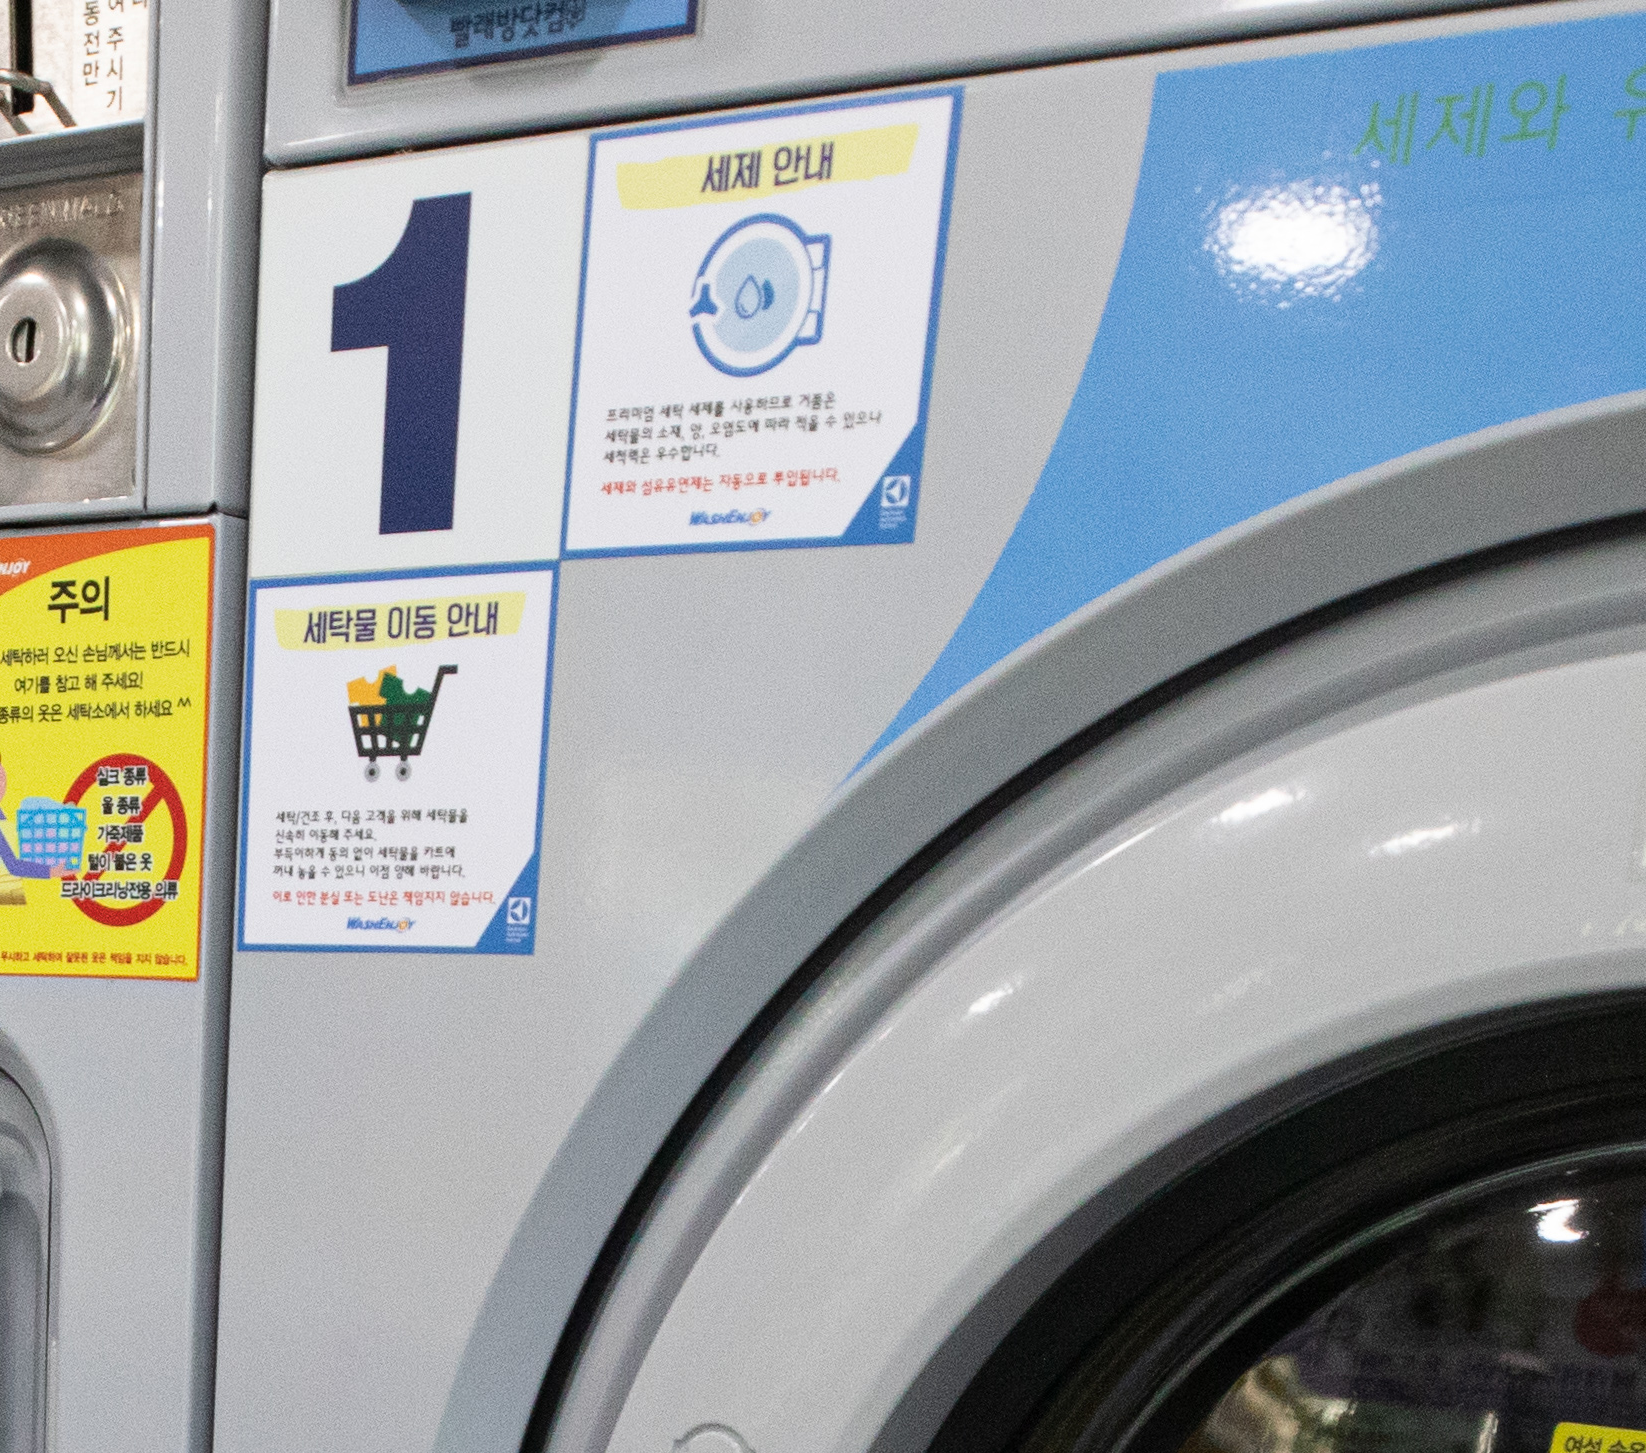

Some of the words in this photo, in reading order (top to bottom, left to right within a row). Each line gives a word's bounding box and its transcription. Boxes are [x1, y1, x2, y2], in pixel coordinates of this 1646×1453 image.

[1354, 74, 1572, 171] 세제와
[700, 150, 761, 194] 세제
[774, 140, 835, 188] 안내
[330, 191, 472, 535] 1
[48, 576, 110, 624] 주의
[303, 608, 377, 644] 세탁물
[387, 605, 437, 640] 이동
[447, 602, 498, 637] 안내
[0, 647, 49, 667] 세탁하러
[53, 645, 79, 664] 오신
[83, 642, 146, 662] 손님께서는
[151, 639, 190, 659] 반드시
[14, 676, 50, 694] 여기를
[56, 675, 80, 692] 참고
[84, 673, 97, 691] 해
[102, 671, 143, 690] 주세요!
[38, 704, 62, 722] 옷은
[67, 701, 130, 720] 세탁소에서
[135, 700, 173, 717] 하세요
[97, 768, 119, 786] 실크
[124, 767, 147, 786] 종류
[102, 797, 113, 815] 울
[117, 796, 141, 815] 종류
[276, 810, 320, 825] 세탁/건조
[324, 811, 337, 824] 후,
[341, 810, 360, 823] 다음
[366, 810, 395, 823] 고객을
[400, 810, 421, 822] 위해
[426, 809, 468, 823] 세탁물을
[98, 825, 144, 843] 가죽제품
[88, 854, 110, 872] 털이
[140, 853, 152, 871] 옷
[61, 882, 151, 899] 드라이크리닝전용
[155, 881, 178, 900] 의류
